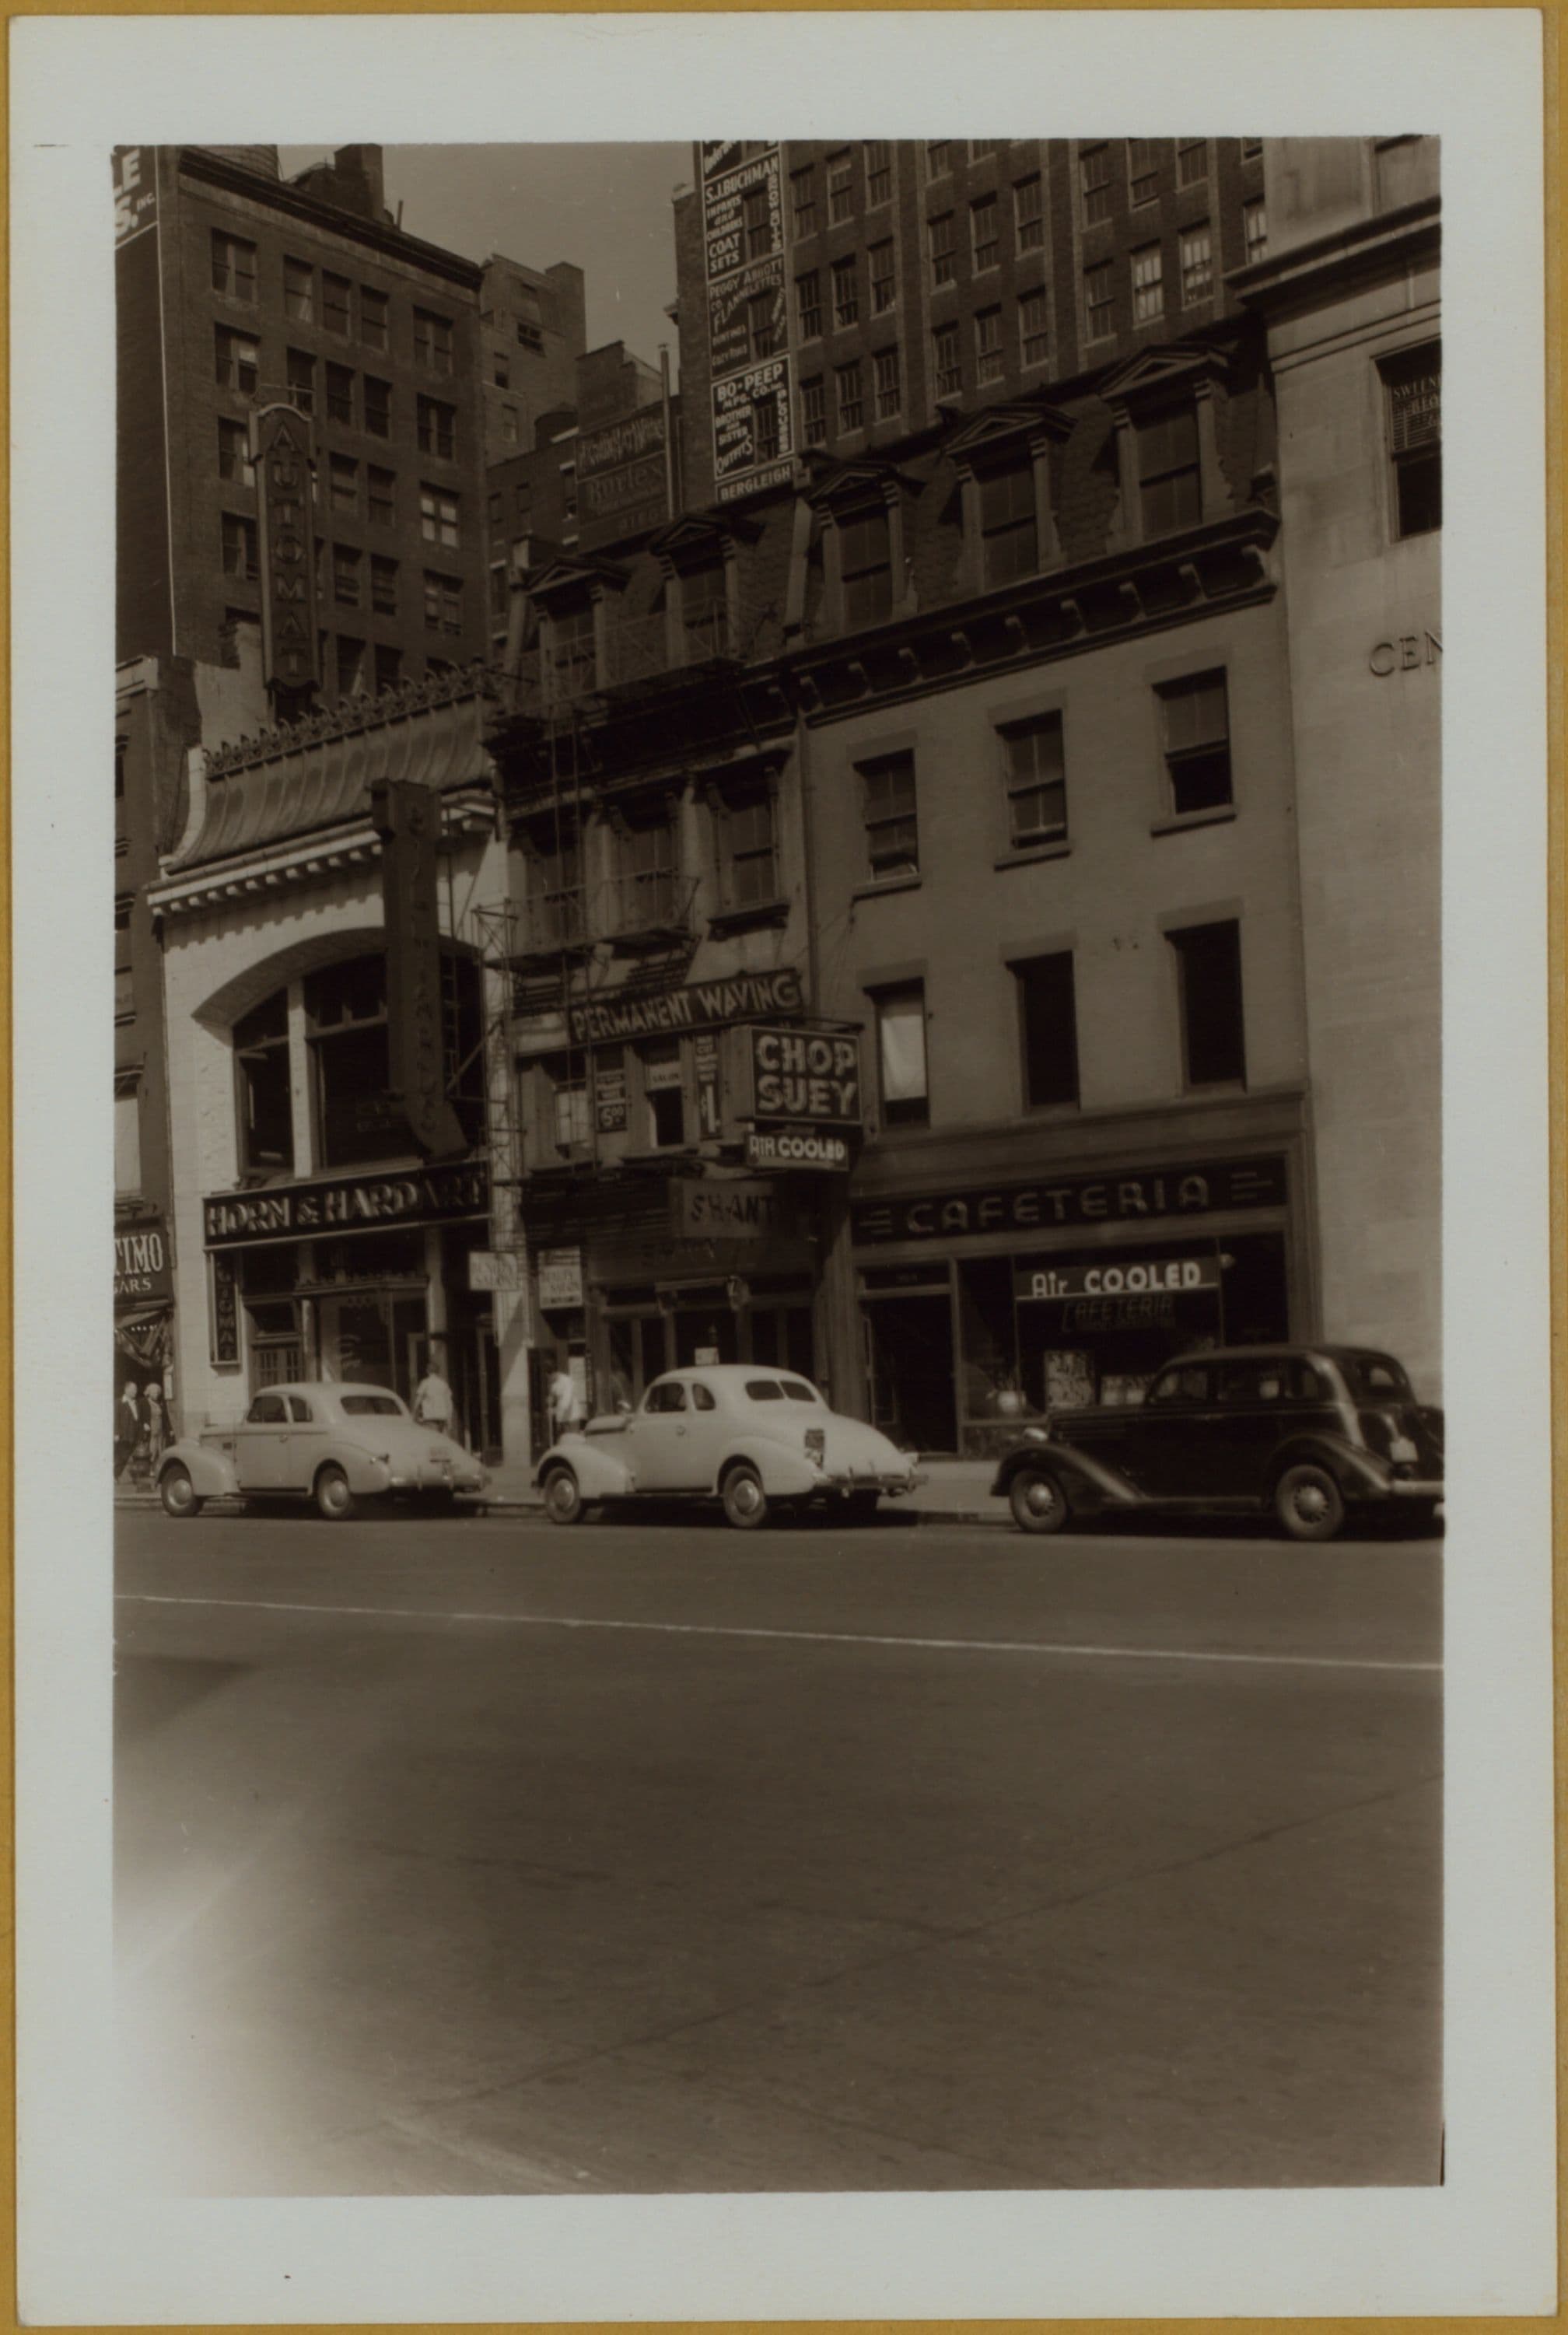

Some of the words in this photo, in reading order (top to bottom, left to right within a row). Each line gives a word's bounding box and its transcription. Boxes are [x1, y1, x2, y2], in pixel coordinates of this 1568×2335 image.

[709, 233, 740, 258] COAT
[710, 250, 740, 273] SETS
[709, 272, 740, 299] PEGGY
[716, 405, 751, 429] BROTHER
[718, 425, 748, 446] SISTER
[720, 464, 791, 500] BERGLEIGH
[267, 422, 308, 677] AUTOMAT
[571, 992, 694, 1041] PERMANENT
[696, 975, 801, 1018] WAVING
[756, 1034, 856, 1076] CHOP
[758, 1074, 857, 1115] SUEY
[778, 1136, 846, 1160] COOLED
[207, 1196, 291, 1237] HORN
[296, 1196, 320, 1227] &
[907, 1175, 1209, 1233] CAFETERIA
[1031, 1271, 1069, 1298] Air
[1084, 1261, 1202, 1293] COOLED
